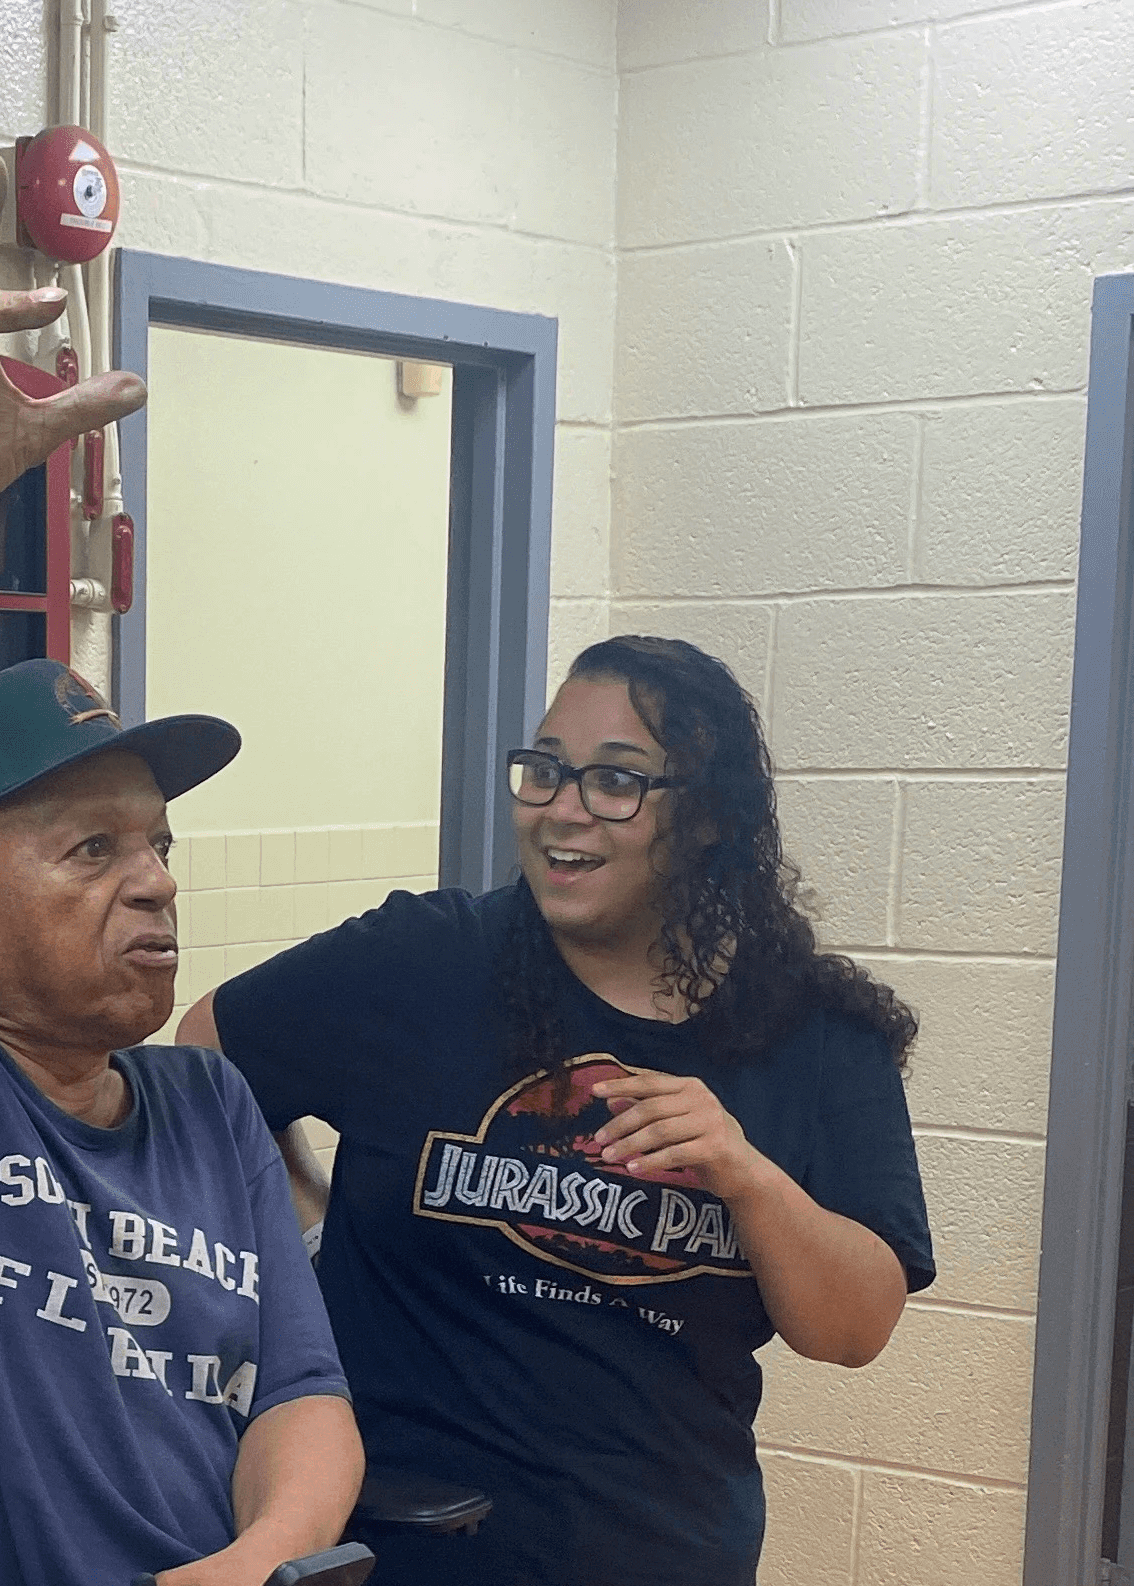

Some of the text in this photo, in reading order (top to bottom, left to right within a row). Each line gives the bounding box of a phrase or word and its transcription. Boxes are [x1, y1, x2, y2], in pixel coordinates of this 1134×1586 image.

[424, 1143, 649, 1240] JURASSIC
[534, 1278, 602, 1306] Finds
[638, 1306, 686, 1337] Way
